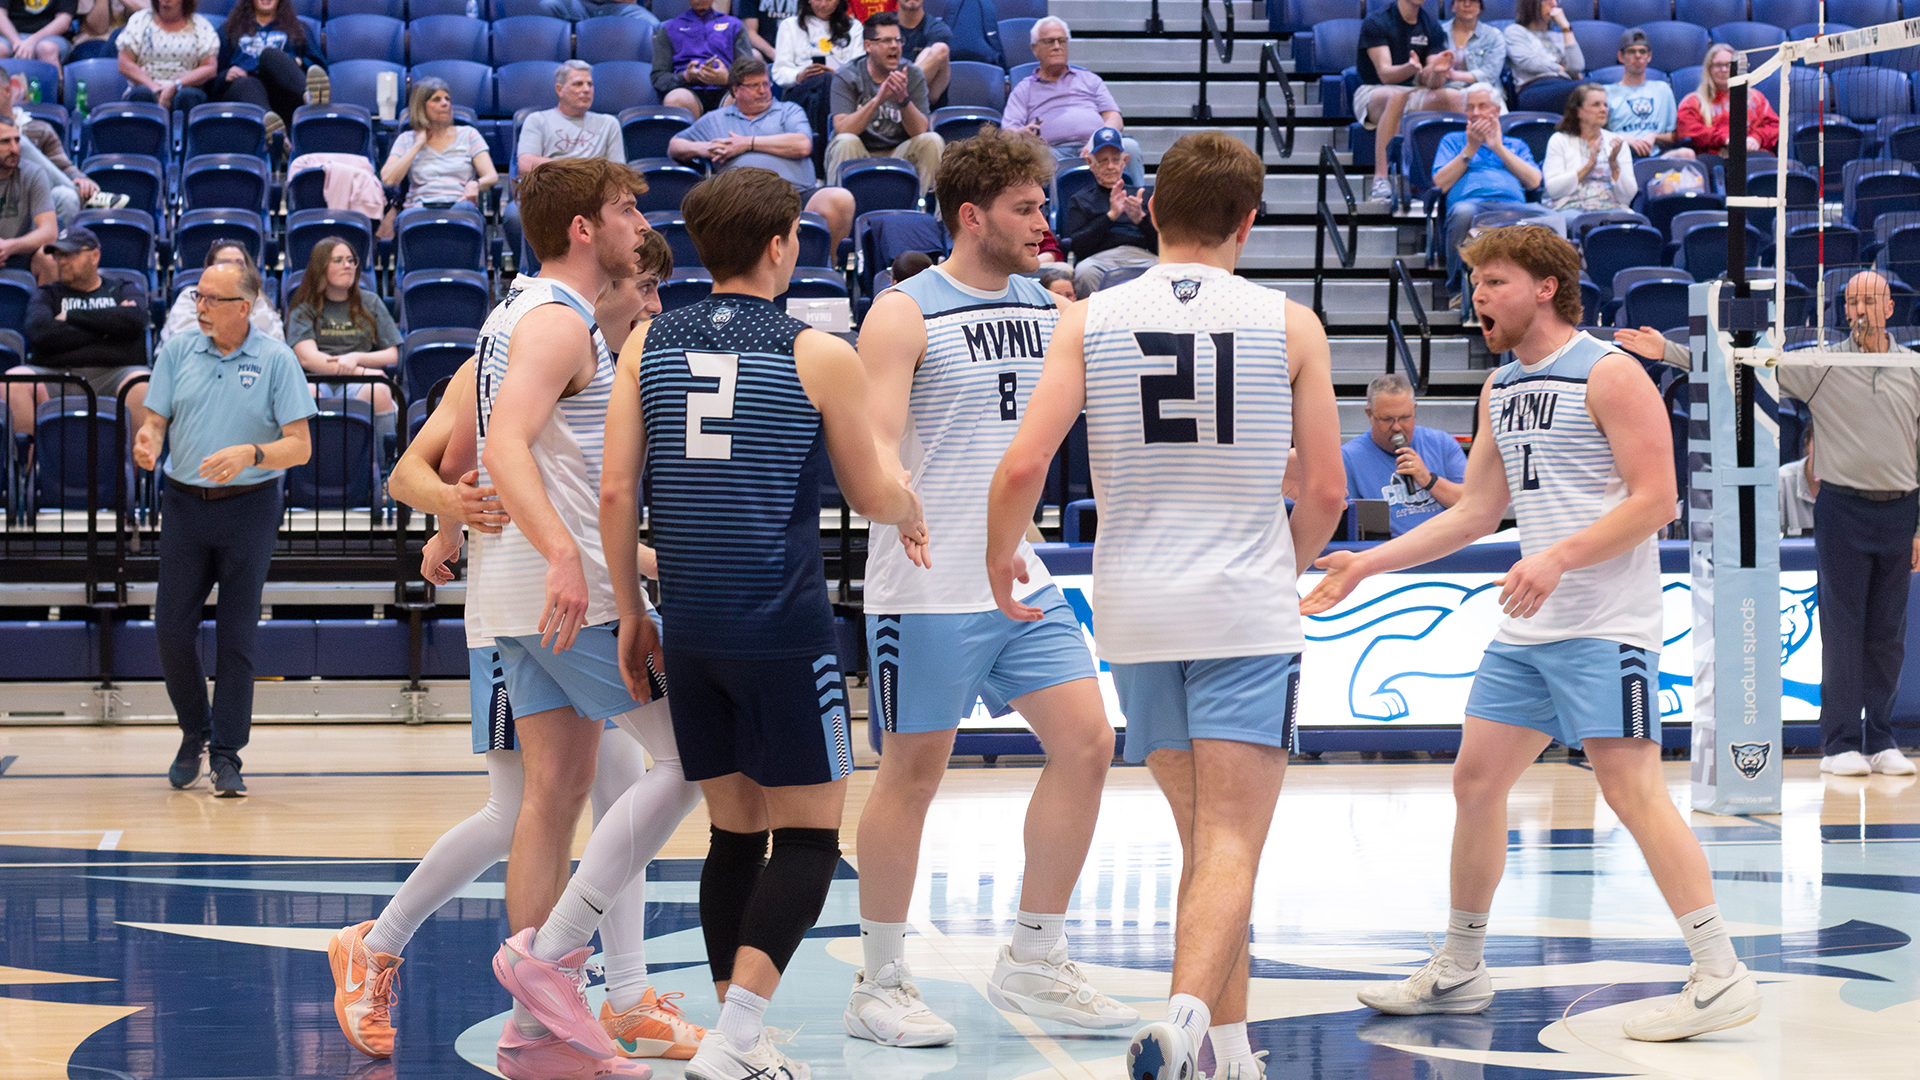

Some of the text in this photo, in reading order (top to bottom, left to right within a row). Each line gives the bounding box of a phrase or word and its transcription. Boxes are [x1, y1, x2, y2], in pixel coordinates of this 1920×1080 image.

[961, 320, 1044, 362] MVNU
[684, 351, 740, 460] 2
[998, 371, 1017, 421] 8
[1131, 331, 1235, 445] 21
[1498, 392, 1558, 434] MVNU
[1740, 597, 1758, 726] sports imports
